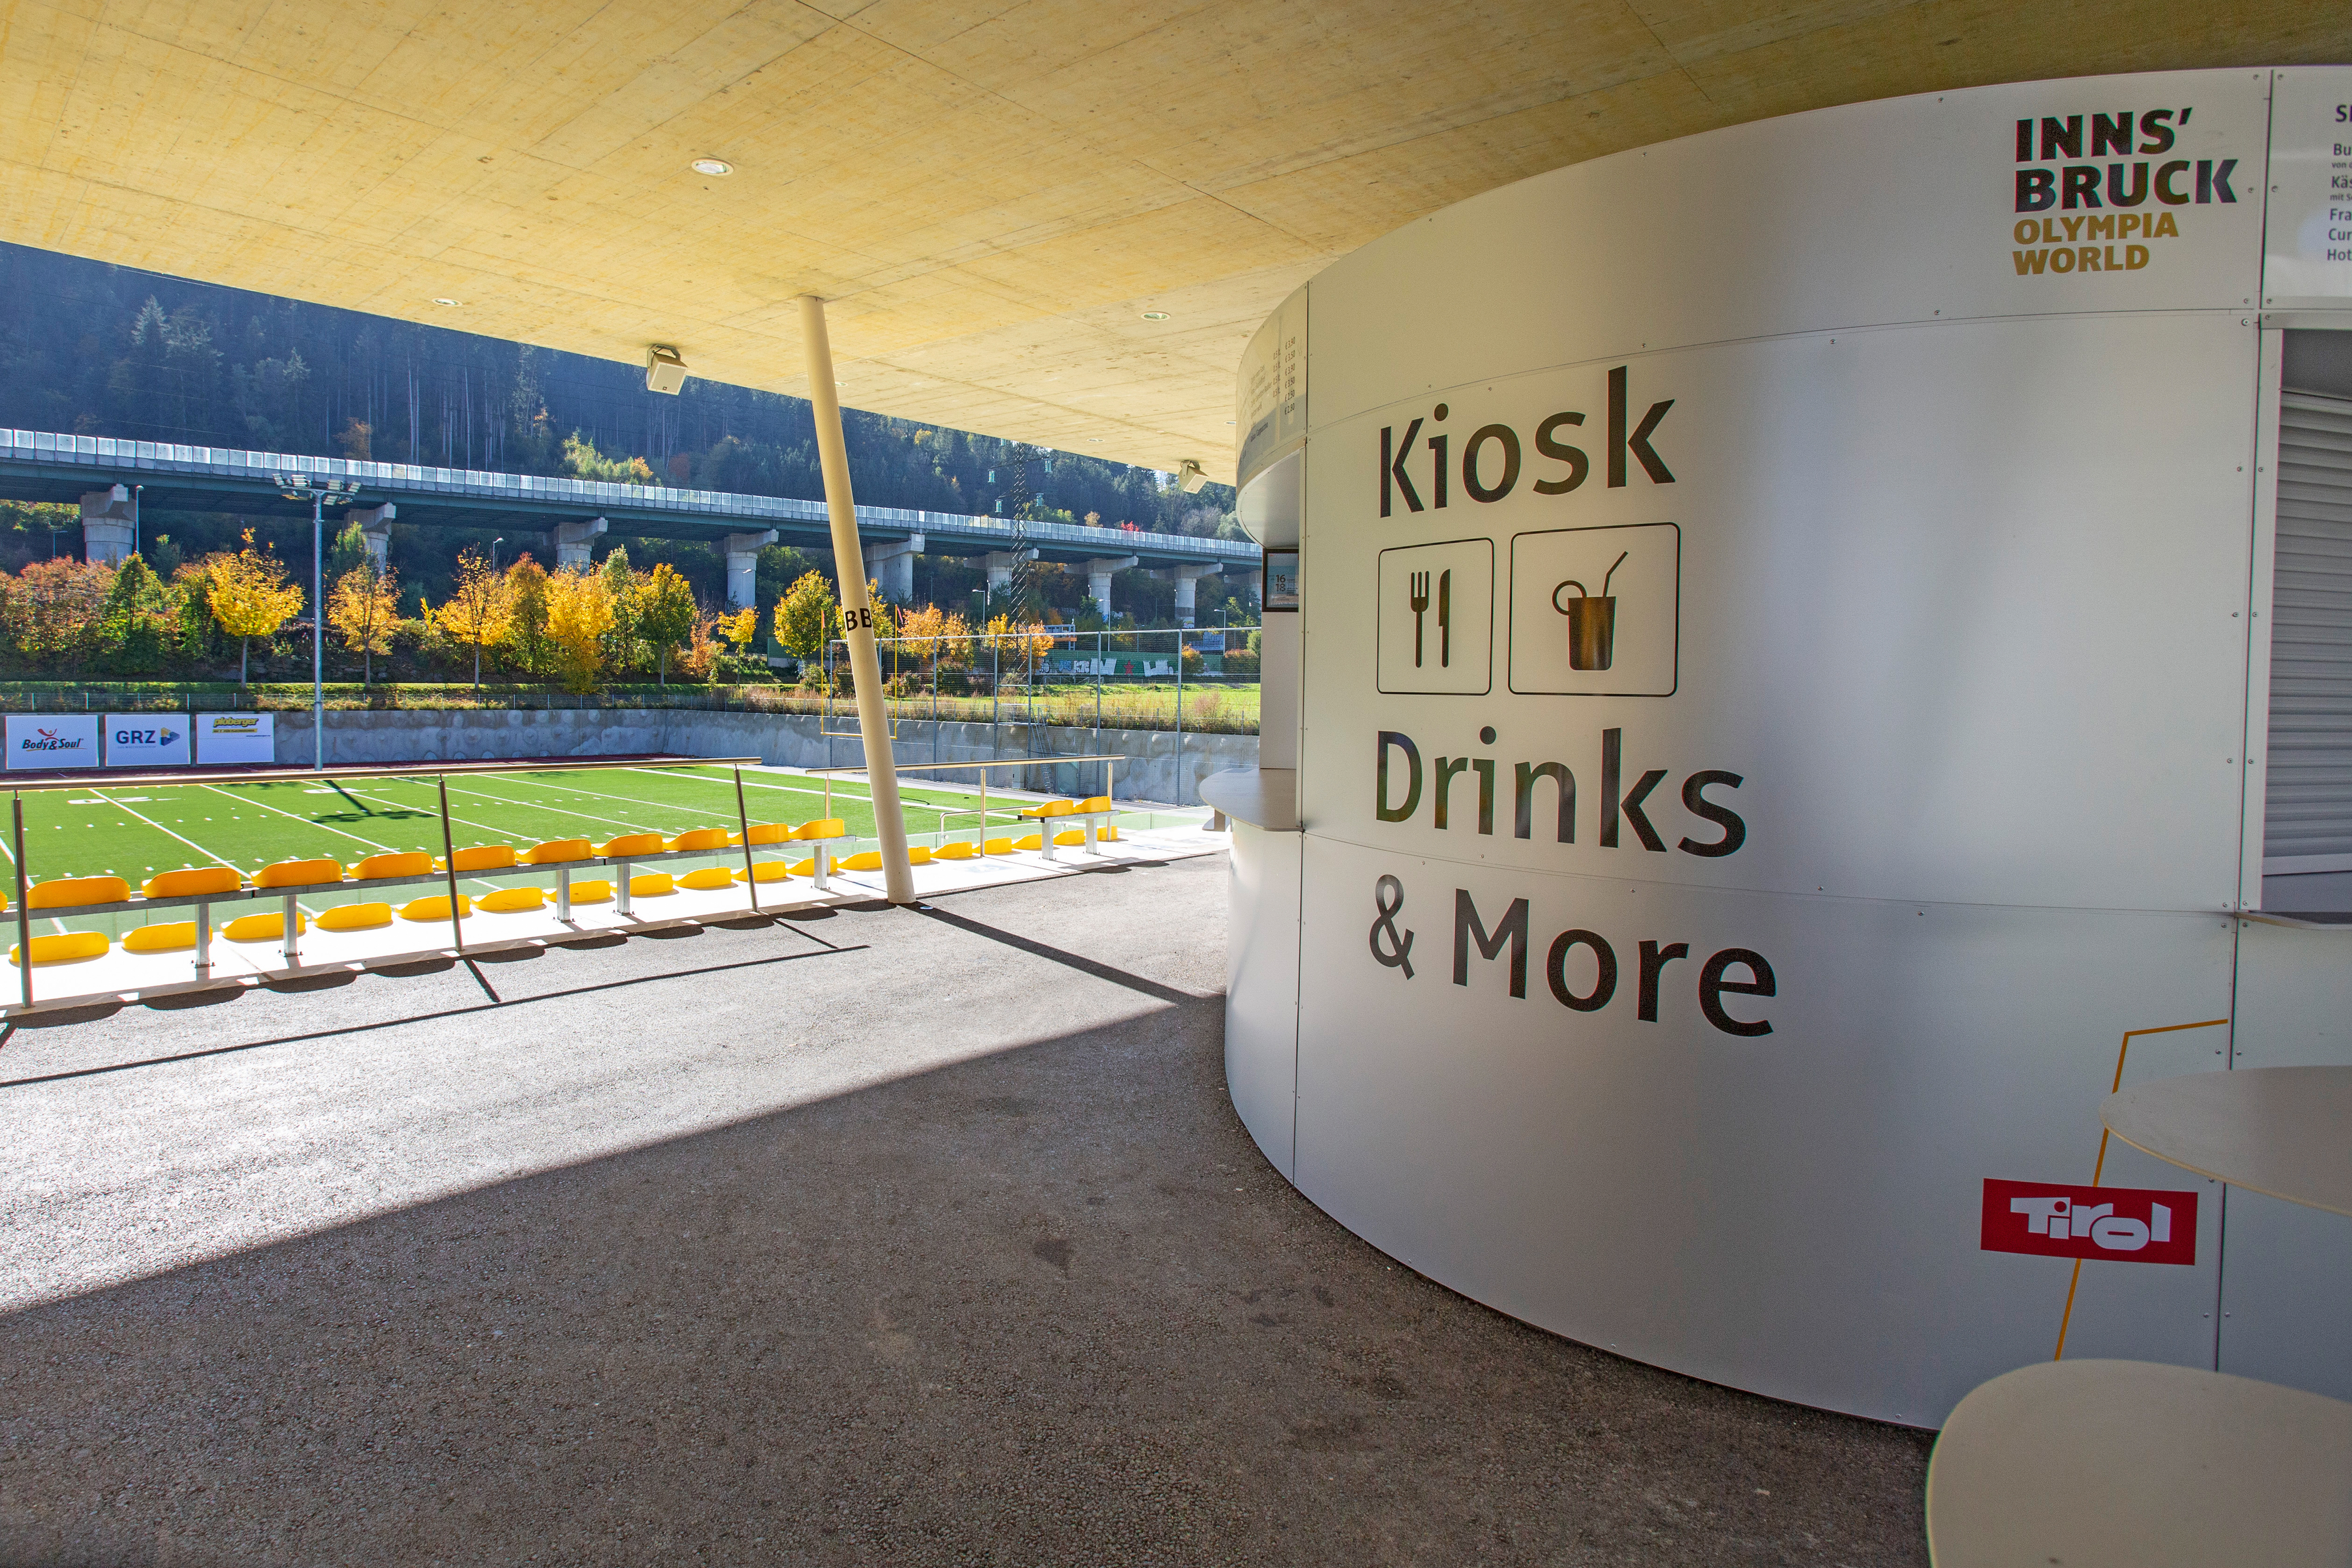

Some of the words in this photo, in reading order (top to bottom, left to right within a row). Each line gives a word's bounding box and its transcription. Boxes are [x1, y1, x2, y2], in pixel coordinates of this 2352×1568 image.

[2015, 159, 2238, 213] BRUCK
[2013, 212, 2179, 245] OLYMPIA
[2013, 245, 2150, 276] WORLD
[1380, 366, 1675, 518] Kiosk
[1276, 574, 1286, 583] 16
[116, 731, 156, 744] GRZ
[213, 717, 259, 728] ploberger
[1376, 726, 1746, 858] Drinks
[1369, 874, 1415, 980] &
[1452, 888, 1776, 1037] More
[2010, 1197, 2171, 1251] Tirol
